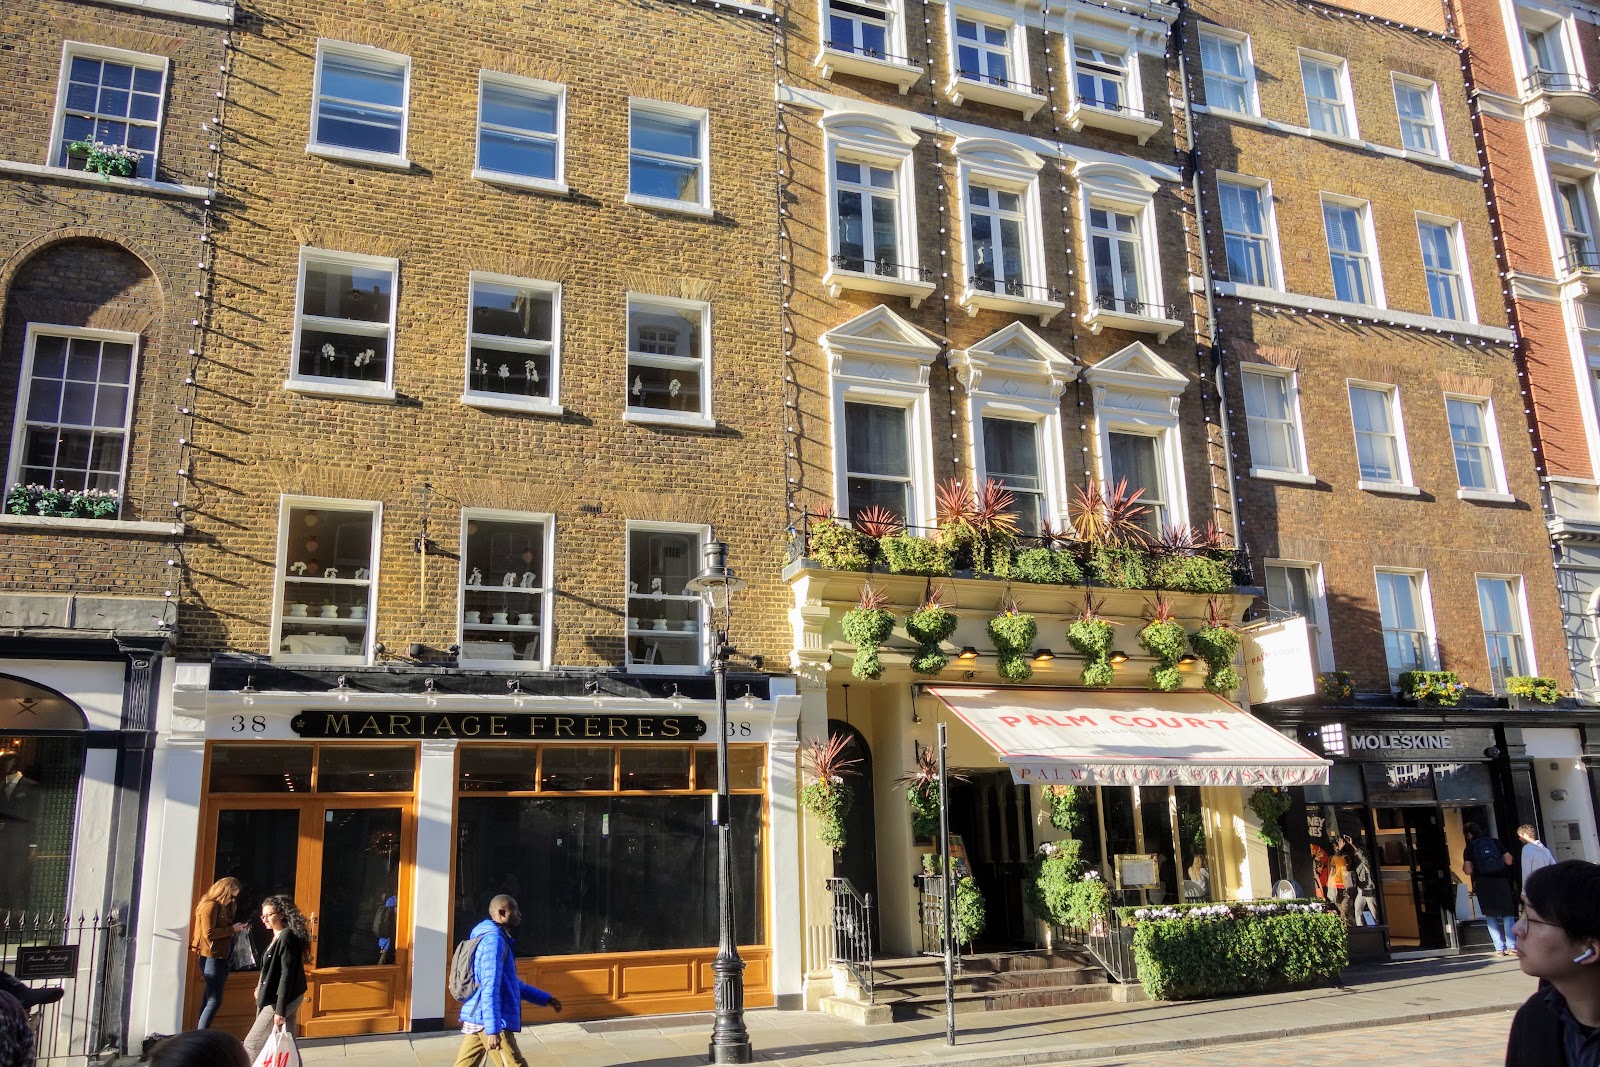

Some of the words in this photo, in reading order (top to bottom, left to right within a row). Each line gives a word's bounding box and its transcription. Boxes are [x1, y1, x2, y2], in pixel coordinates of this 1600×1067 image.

[231, 714, 267, 733] 38
[324, 714, 508, 736] MARIAGE
[726, 721, 752, 737] 38
[997, 714, 1099, 728] PALM
[1108, 714, 1231, 731] COURT
[1350, 734, 1453, 750] MOLESKINE
[1020, 767, 1083, 780] PALM
[1099, 767, 1175, 780] COURT
[1192, 767, 1319, 781] BRASSERIE
